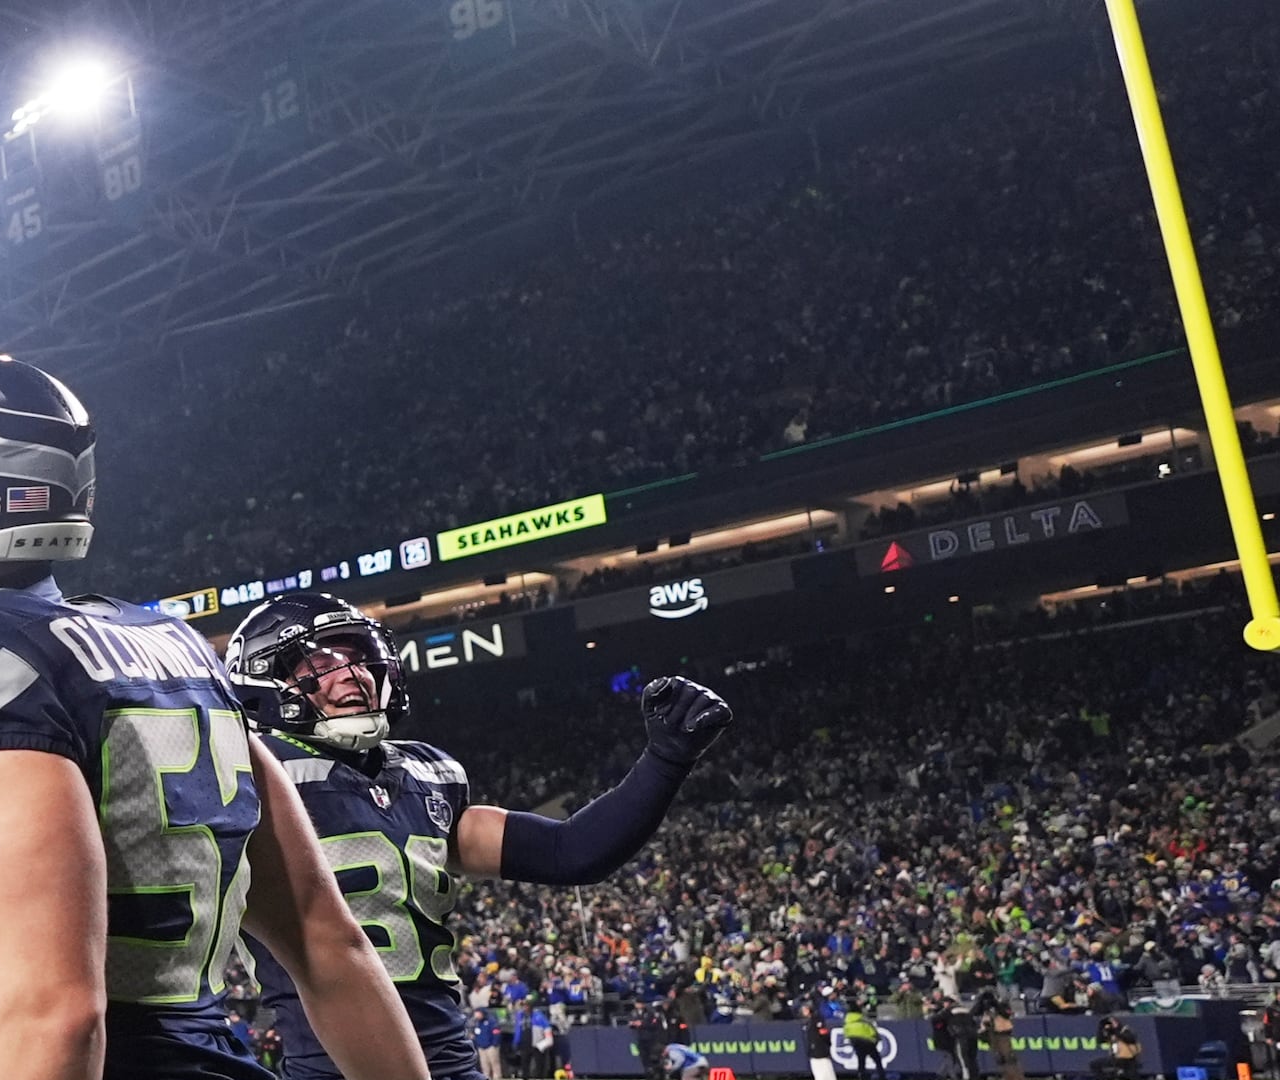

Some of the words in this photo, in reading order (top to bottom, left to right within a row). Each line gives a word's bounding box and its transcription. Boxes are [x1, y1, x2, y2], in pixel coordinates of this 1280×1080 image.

[7, 203, 42, 245] 45
[456, 505, 587, 552] SEAHAWKS
[928, 501, 1104, 562] DELTA
[649, 578, 705, 608] aws
